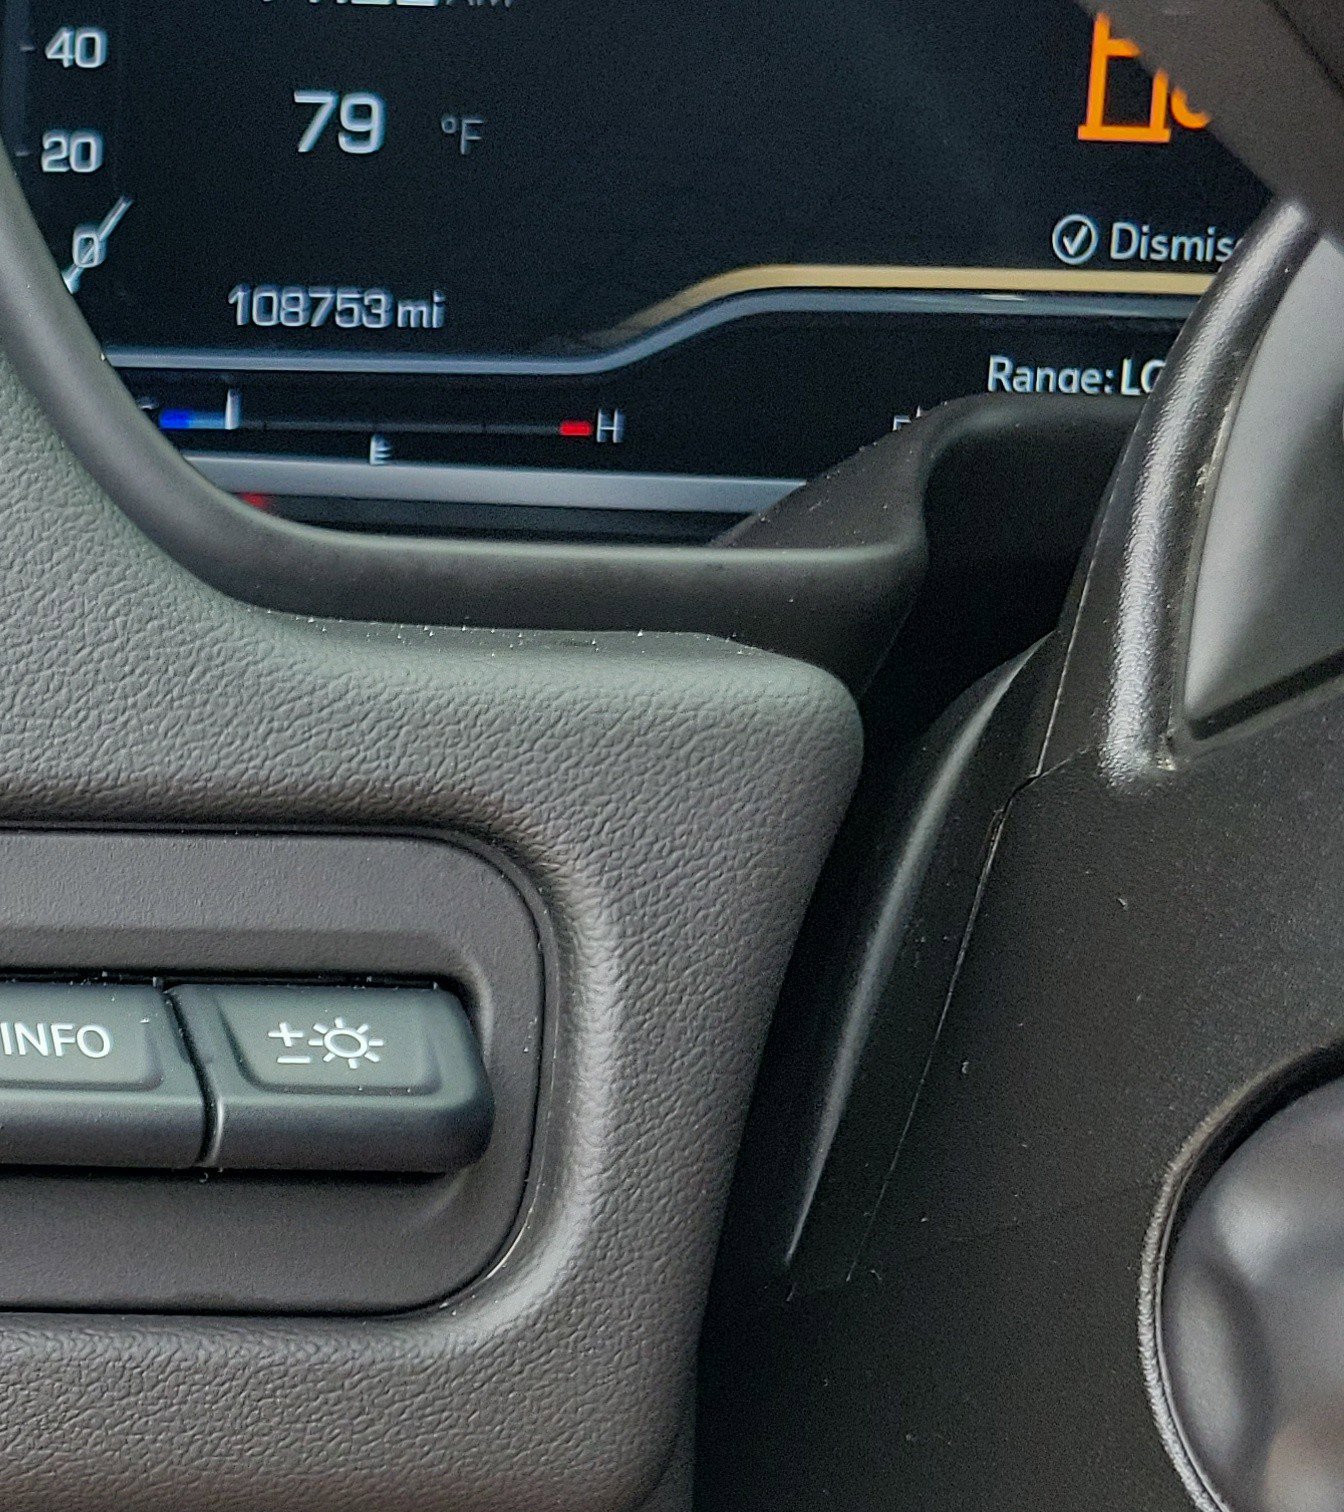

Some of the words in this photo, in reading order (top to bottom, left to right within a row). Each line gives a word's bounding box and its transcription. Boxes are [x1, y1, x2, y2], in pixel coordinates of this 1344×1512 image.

[44, 26, 108, 69] 40
[292, 90, 385, 154] 79
[41, 130, 104, 173] 20
[1109, 221, 1243, 262] Dismis
[595, 407, 624, 443] H
[0, 1021, 112, 1059] INFO
